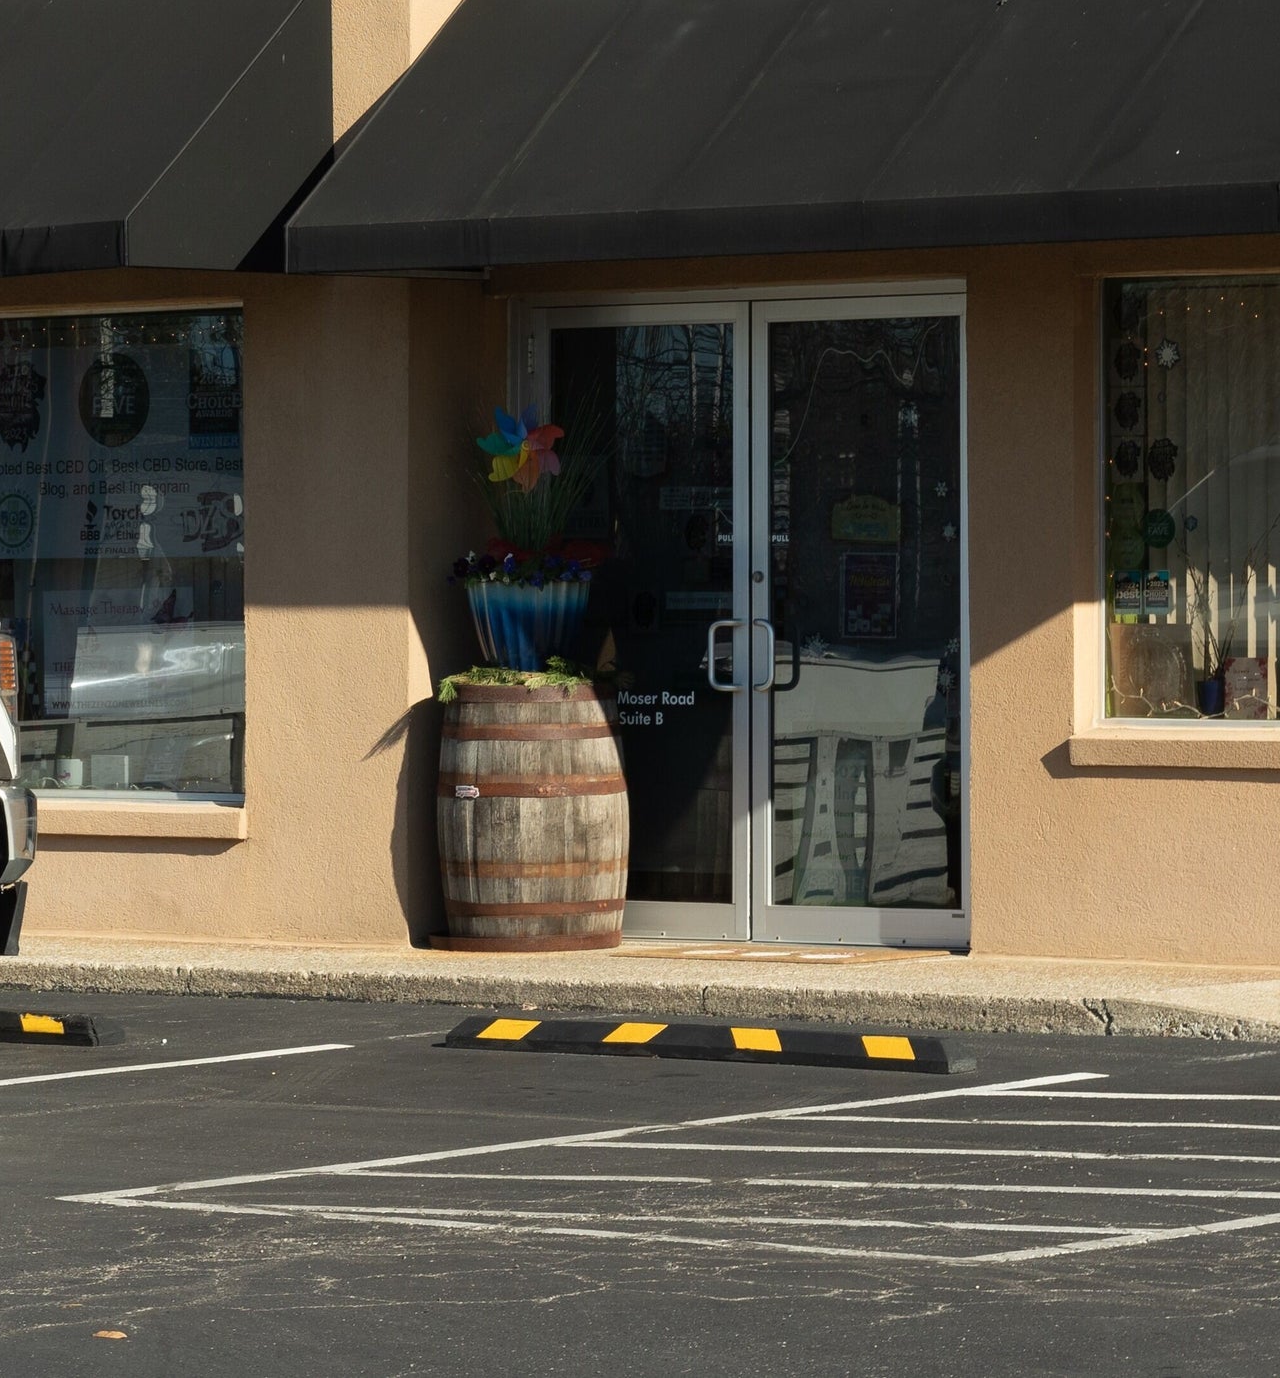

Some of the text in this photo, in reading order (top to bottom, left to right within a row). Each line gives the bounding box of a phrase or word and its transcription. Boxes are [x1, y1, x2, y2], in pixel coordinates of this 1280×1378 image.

[92, 395, 135, 415] FVE
[187, 392, 242, 409] CHOICE
[190, 436, 238, 447] WINNER
[26, 461, 52, 475] Best
[56, 460, 84, 473] CBD
[112, 459, 138, 472] Best
[143, 458, 170, 472] CBD
[175, 457, 211, 473] Store,
[215, 457, 243, 471] Best
[40, 480, 190, 497] Blog, and Best Inagram
[80, 530, 100, 541] BBB
[116, 530, 140, 540] Ethic
[717, 534, 734, 542] PUL
[772, 534, 789, 542] PULL
[1116, 589, 1140, 599] best
[49, 601, 145, 617] Massage Therapy
[618, 691, 695, 706] Moser Road
[619, 712, 664, 725] Suite B
